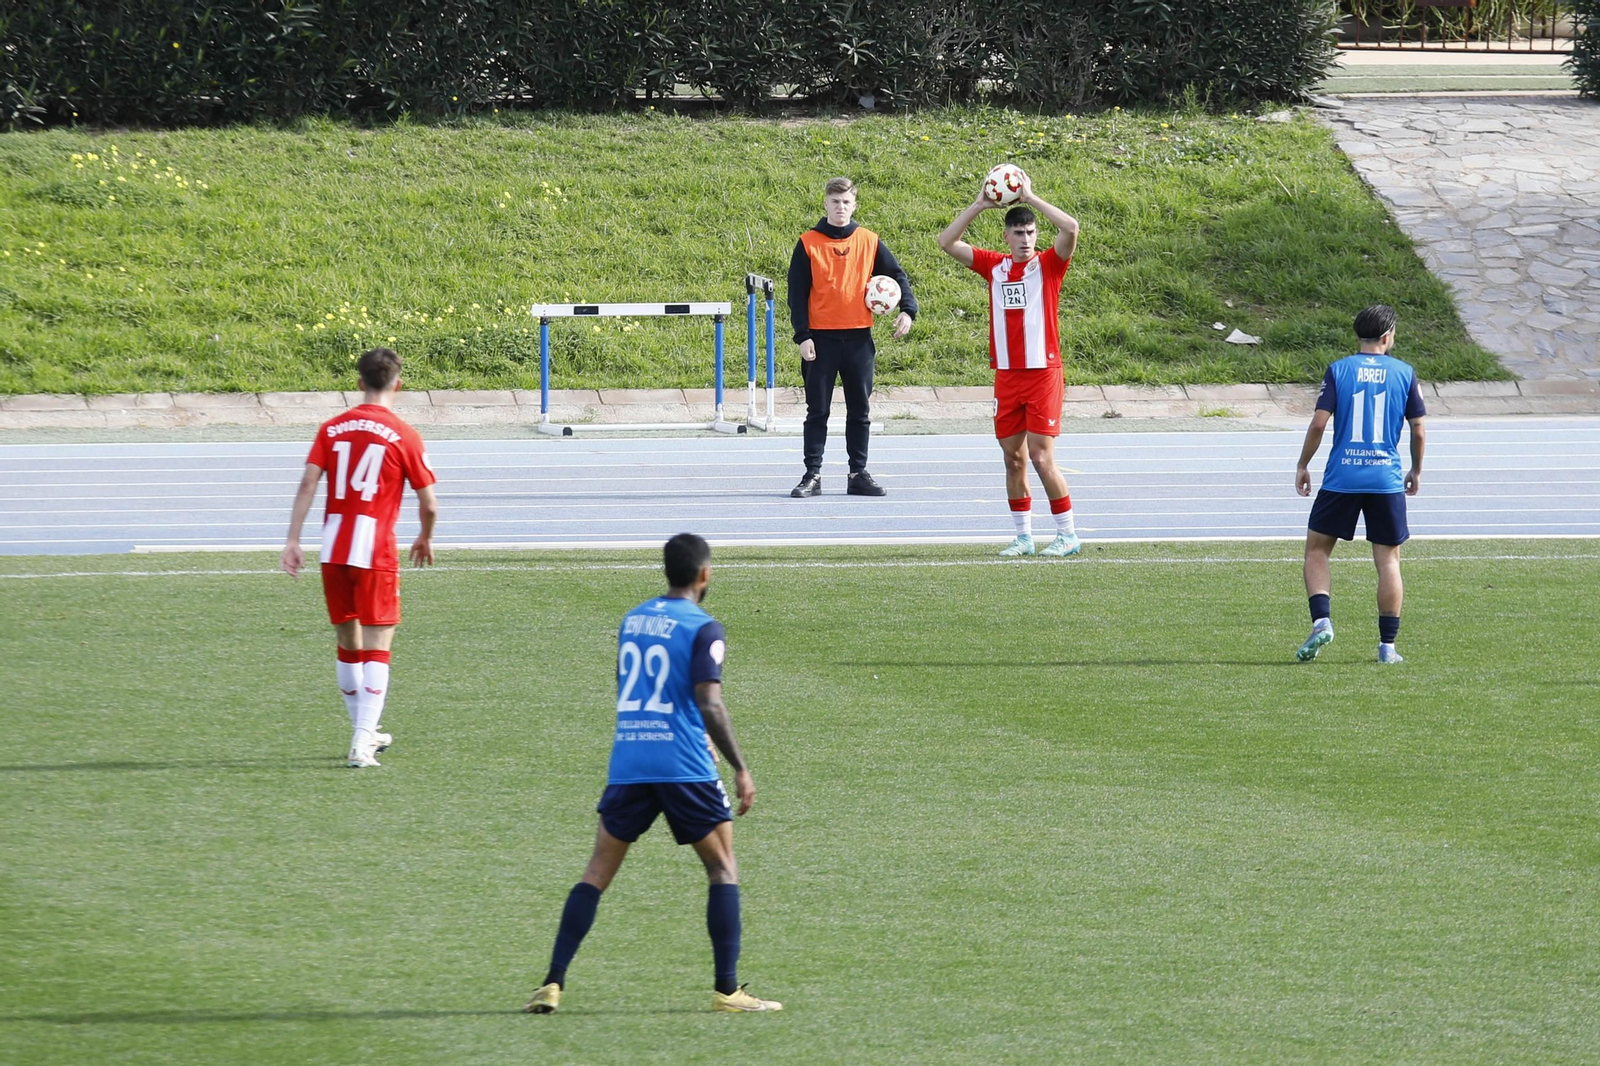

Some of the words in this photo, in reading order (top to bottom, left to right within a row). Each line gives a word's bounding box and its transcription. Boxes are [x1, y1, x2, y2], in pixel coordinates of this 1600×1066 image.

[1007, 288, 1020, 296] DA
[1008, 296, 1021, 304] ZN
[1357, 367, 1387, 384] ABREU
[1350, 390, 1386, 443] 11
[331, 440, 387, 502] 14
[617, 641, 674, 714] 22
